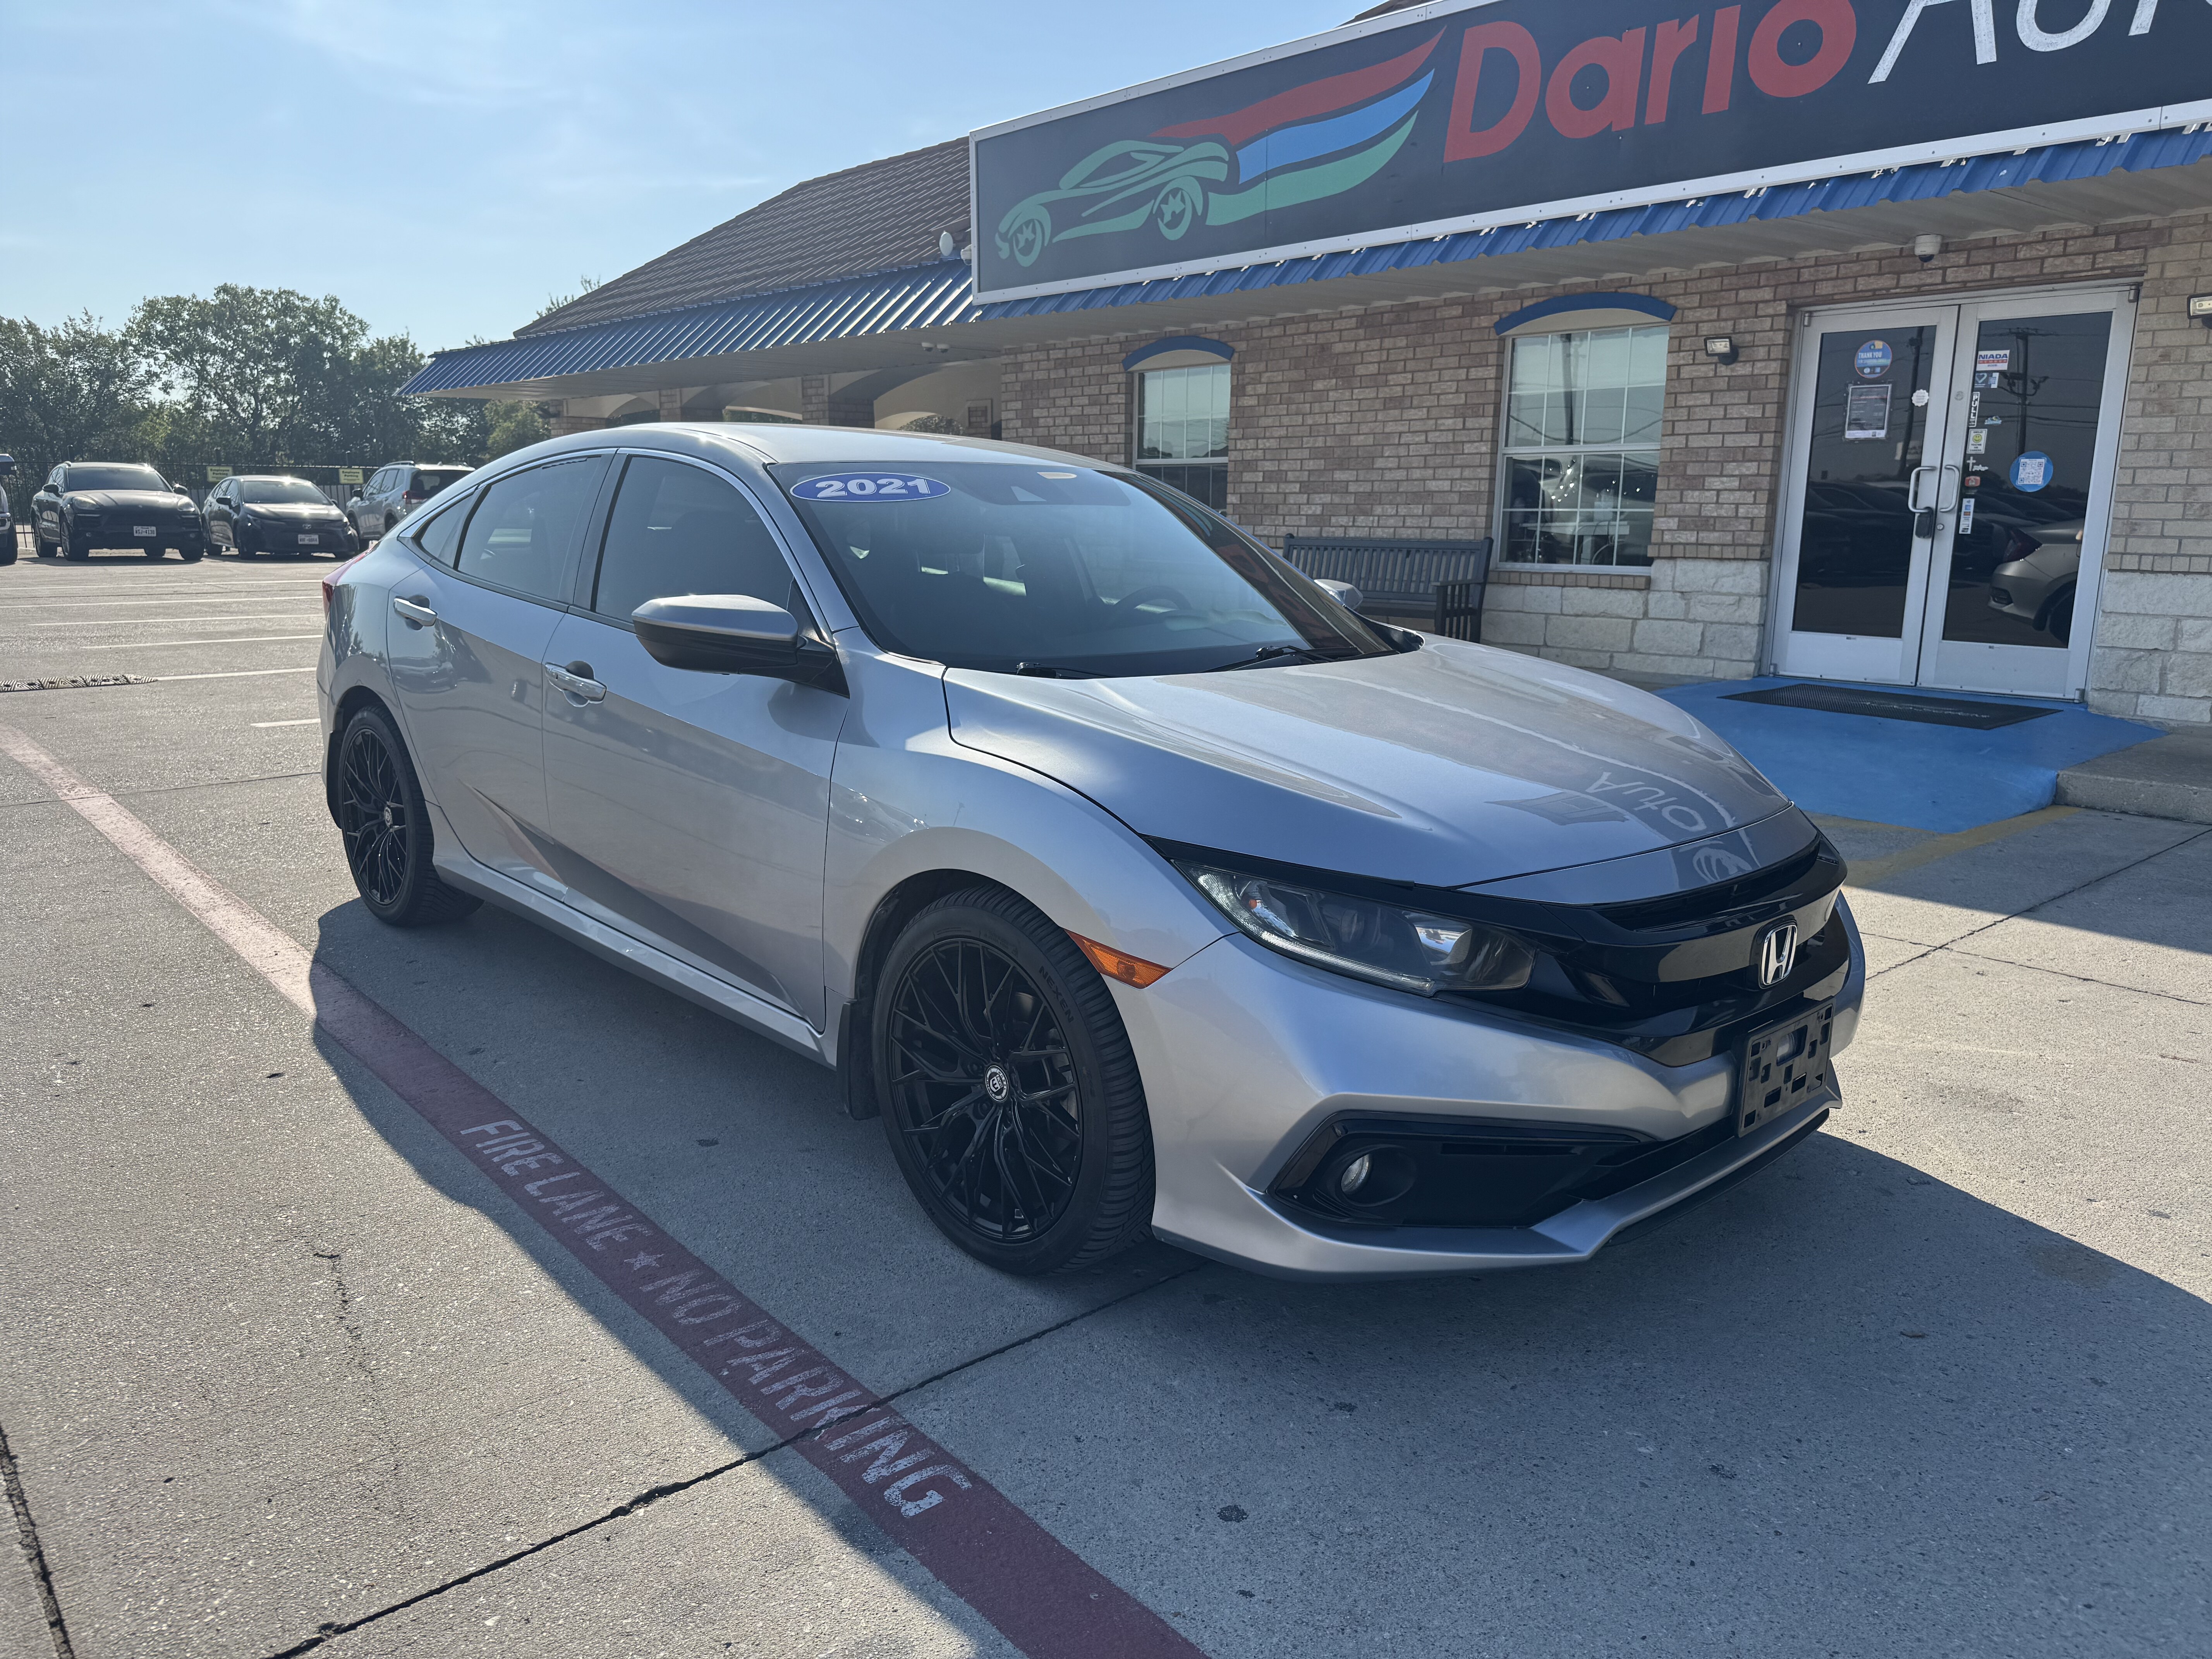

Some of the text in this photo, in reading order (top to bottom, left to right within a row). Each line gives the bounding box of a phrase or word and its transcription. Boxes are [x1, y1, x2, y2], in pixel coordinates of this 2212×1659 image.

[816, 479, 930, 498] 2021
[1039, 966, 1074, 1023] NEXEN
[460, 1119, 973, 1518] FIRE LANE NO PARKING
